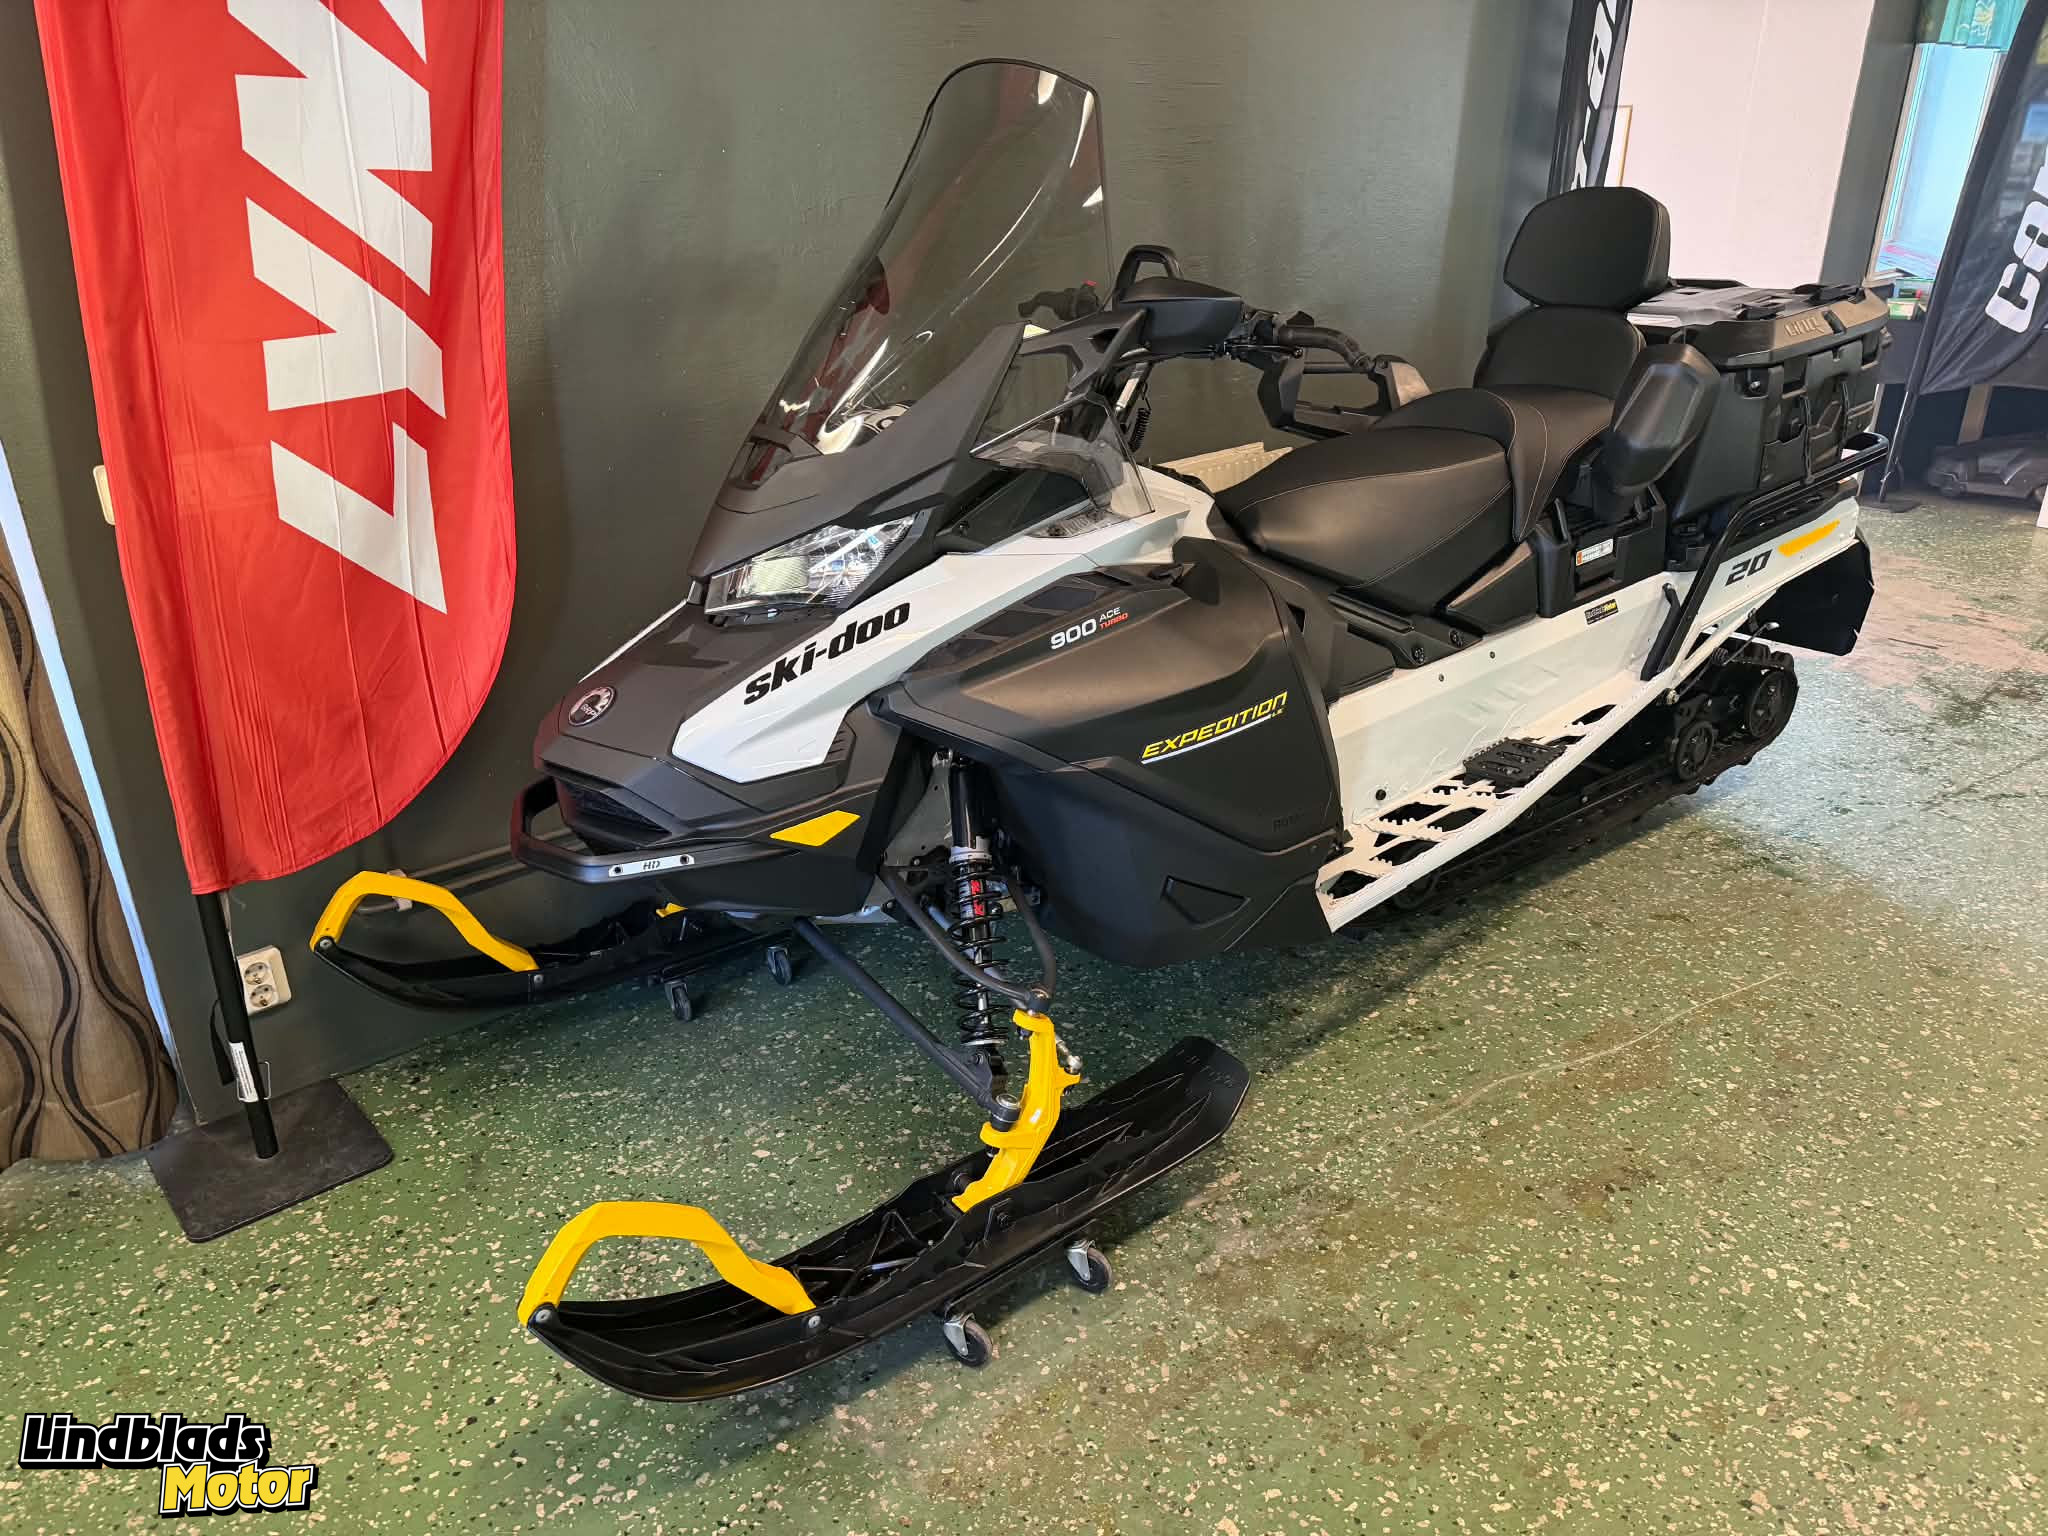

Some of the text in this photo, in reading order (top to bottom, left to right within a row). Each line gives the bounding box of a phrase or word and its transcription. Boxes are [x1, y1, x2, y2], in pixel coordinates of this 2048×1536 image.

[1725, 549, 1773, 587] 20
[1100, 607, 1121, 622] ACE
[1100, 612, 1129, 629] TURBO
[1051, 618, 1097, 650] 900
[744, 602, 910, 705] ski-doo
[1142, 690, 1288, 759] EXPEDITION
[643, 860, 661, 870] HD
